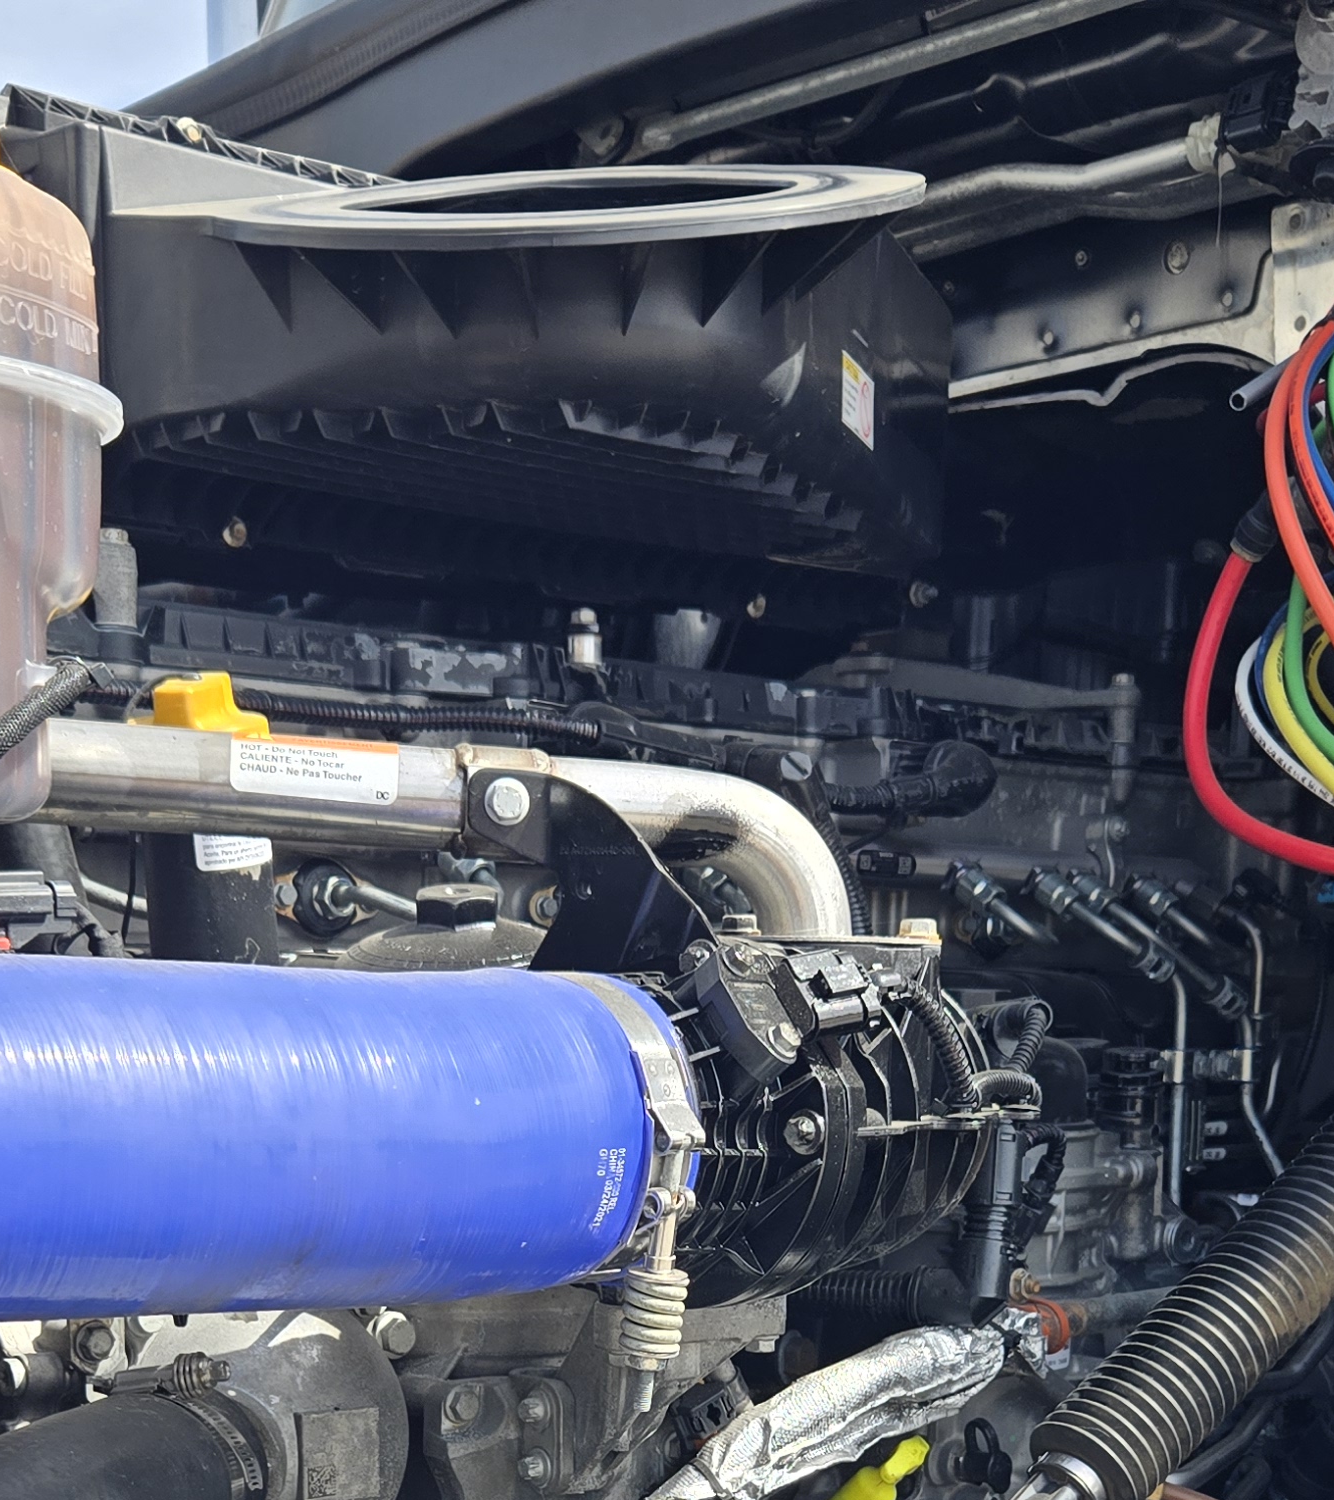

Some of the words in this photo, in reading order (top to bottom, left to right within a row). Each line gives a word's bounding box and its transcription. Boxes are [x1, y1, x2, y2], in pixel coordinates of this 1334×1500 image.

[240, 752, 292, 764] CALIENTE
[301, 758, 315, 767] No
[317, 759, 345, 769] Tocar
[308, 749, 338, 759] Touch
[240, 763, 277, 774] CHAUD
[286, 767, 300, 777] Ne
[302, 769, 320, 779] Pas
[323, 771, 363, 782] Toucher
[376, 791, 390, 800] DC
